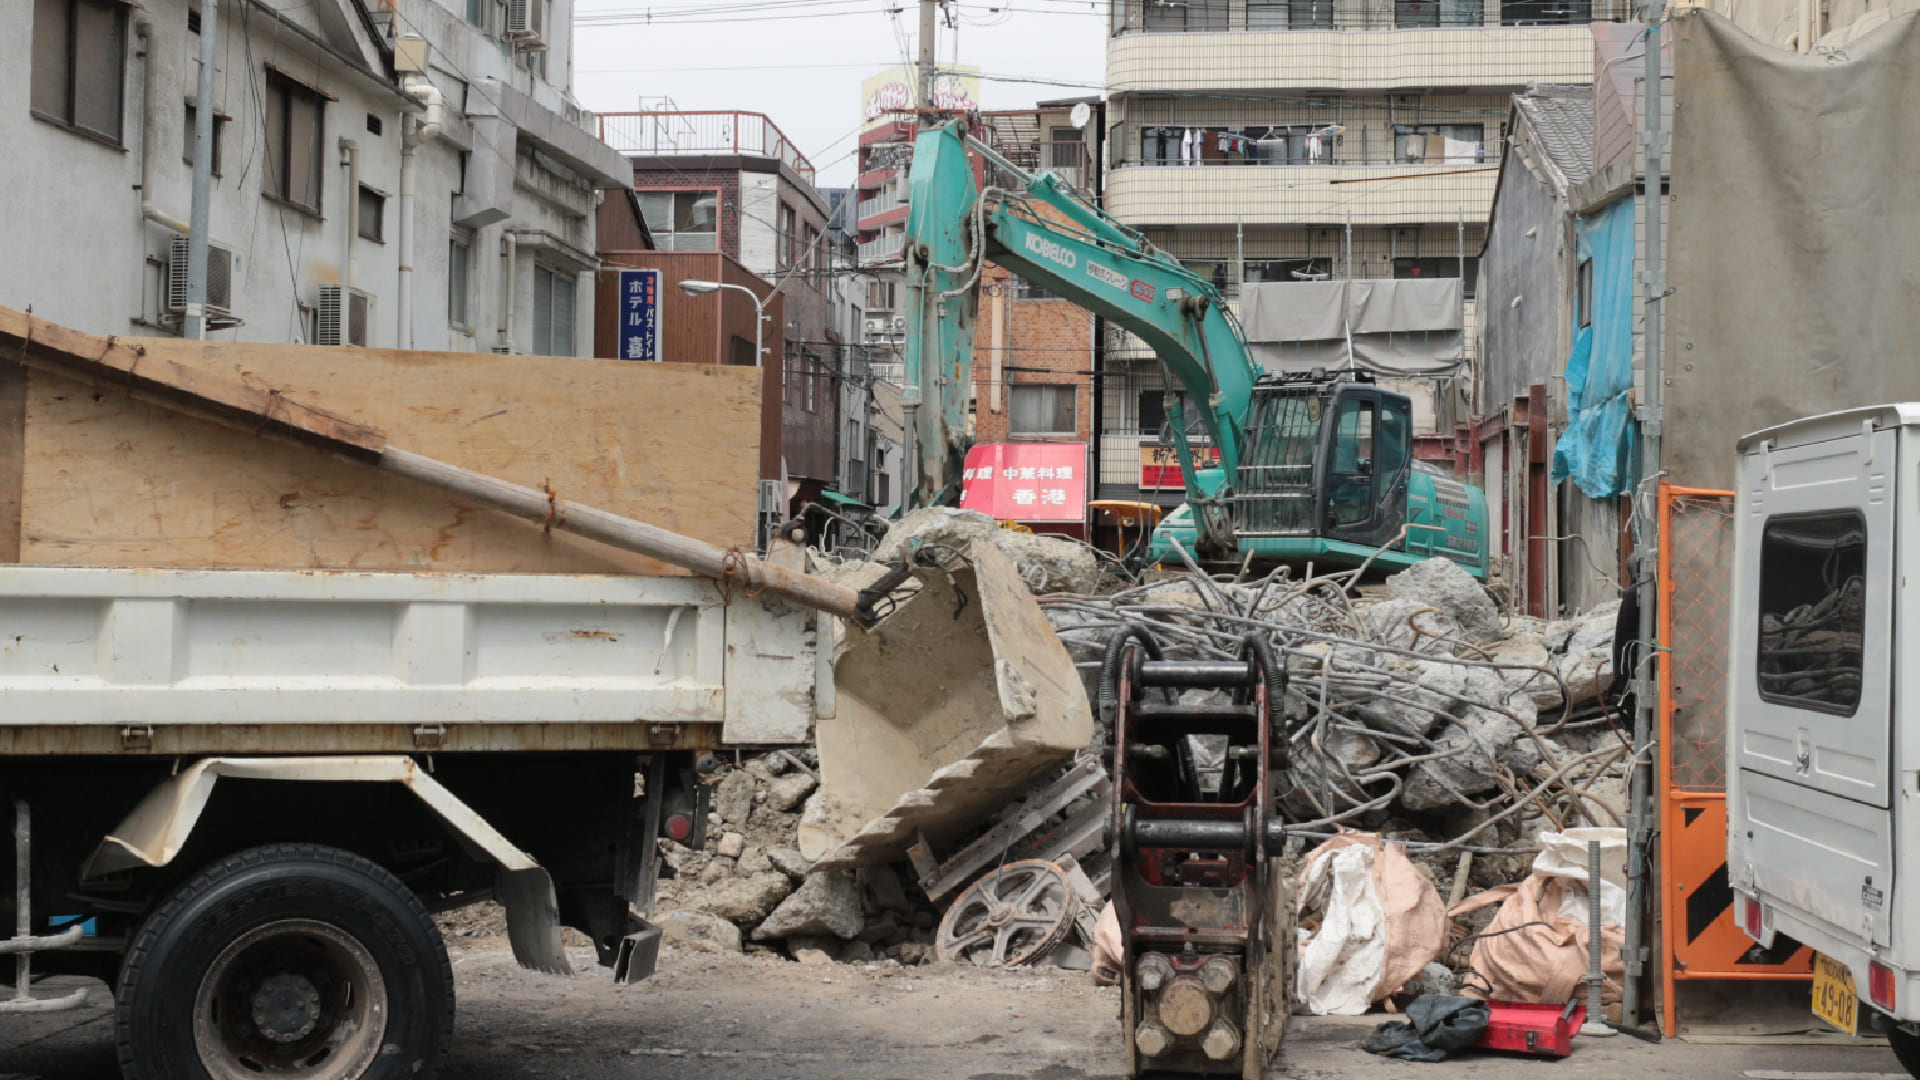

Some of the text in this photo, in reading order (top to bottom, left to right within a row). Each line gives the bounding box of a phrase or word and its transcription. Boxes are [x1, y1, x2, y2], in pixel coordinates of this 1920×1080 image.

[1026, 232, 1076, 268] KOBELCO
[1003, 465, 1073, 480] 中華料理
[1012, 488, 1066, 505] 香港
